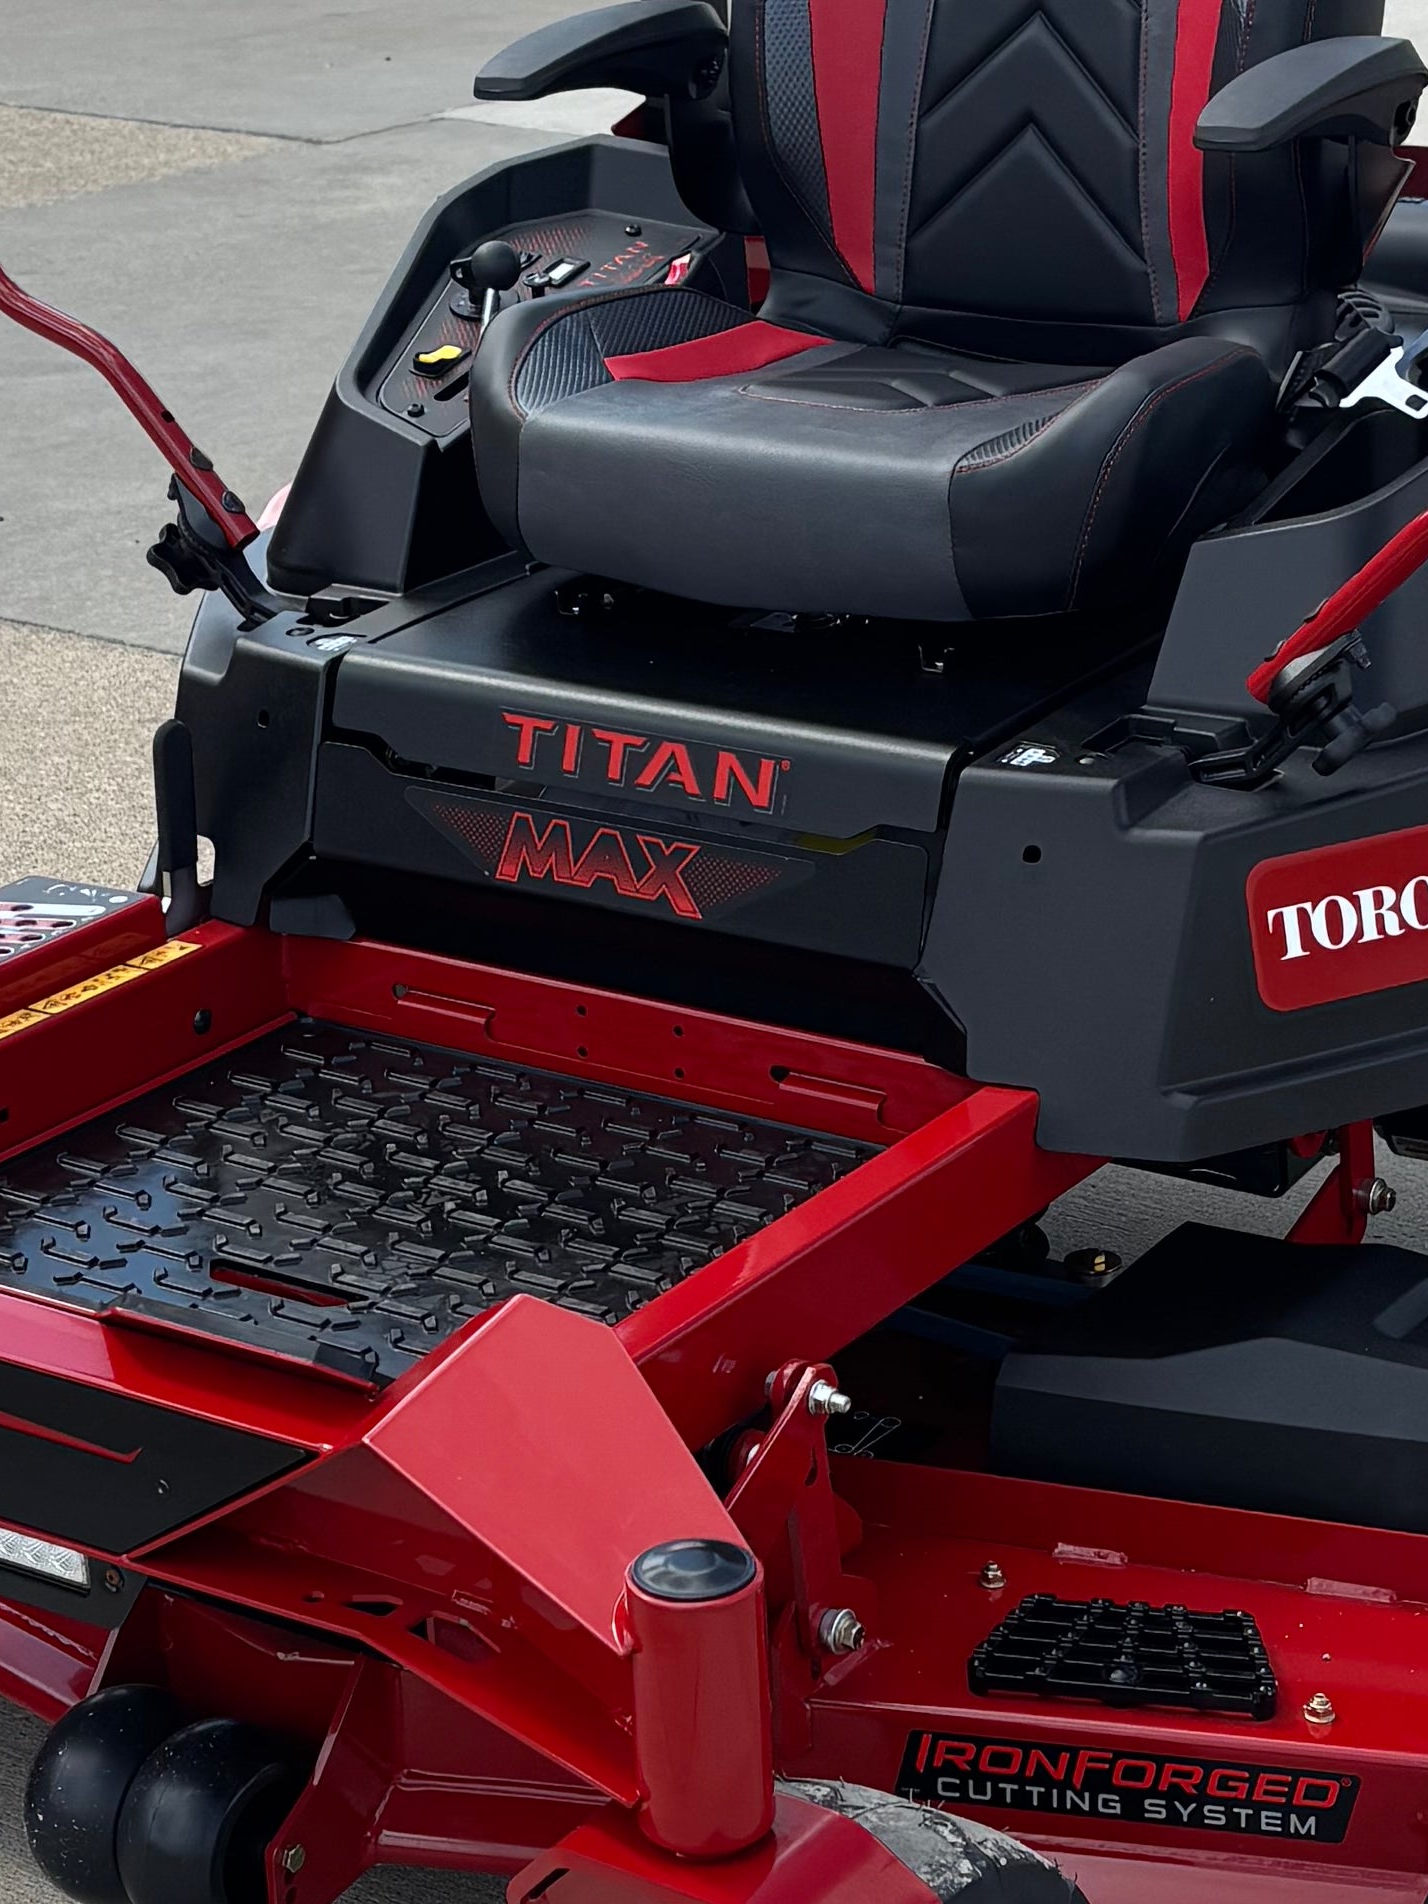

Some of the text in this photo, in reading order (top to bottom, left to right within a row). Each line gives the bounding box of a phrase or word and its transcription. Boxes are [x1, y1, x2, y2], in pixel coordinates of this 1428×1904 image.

[501, 712, 777, 811] TITAN
[495, 811, 702, 920] MAX
[937, 1776, 1317, 1836] CUTTING SYSTEM
